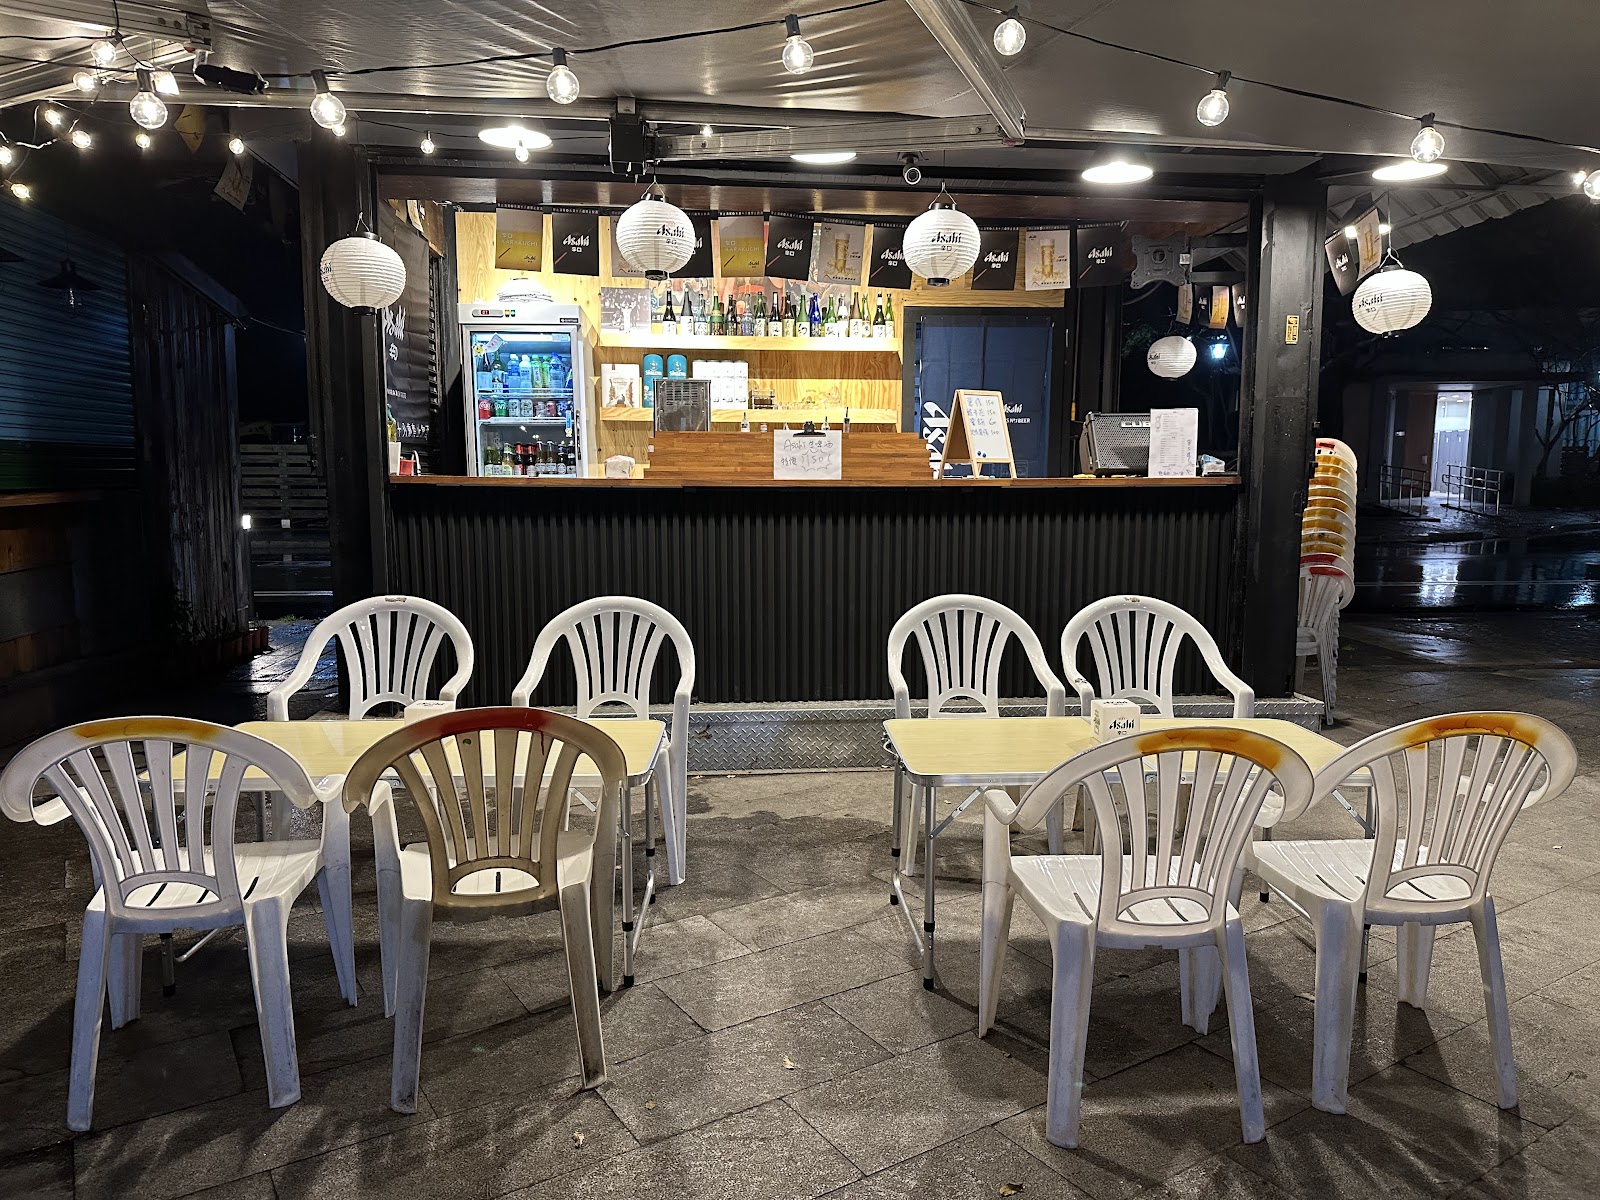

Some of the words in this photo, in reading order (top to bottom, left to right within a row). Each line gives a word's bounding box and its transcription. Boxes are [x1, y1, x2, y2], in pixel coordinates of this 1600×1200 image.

[656, 224, 685, 238] Asahi
[931, 231, 962, 244] Asahi
[562, 234, 590, 247] Asahi
[777, 237, 804, 251] Asahi
[984, 251, 1010, 263] Asahi
[1087, 246, 1113, 259] Asahi
[1358, 293, 1383, 308] Asahi
[783, 439, 806, 451] Asahi
[1109, 719, 1134, 729] Asahi
